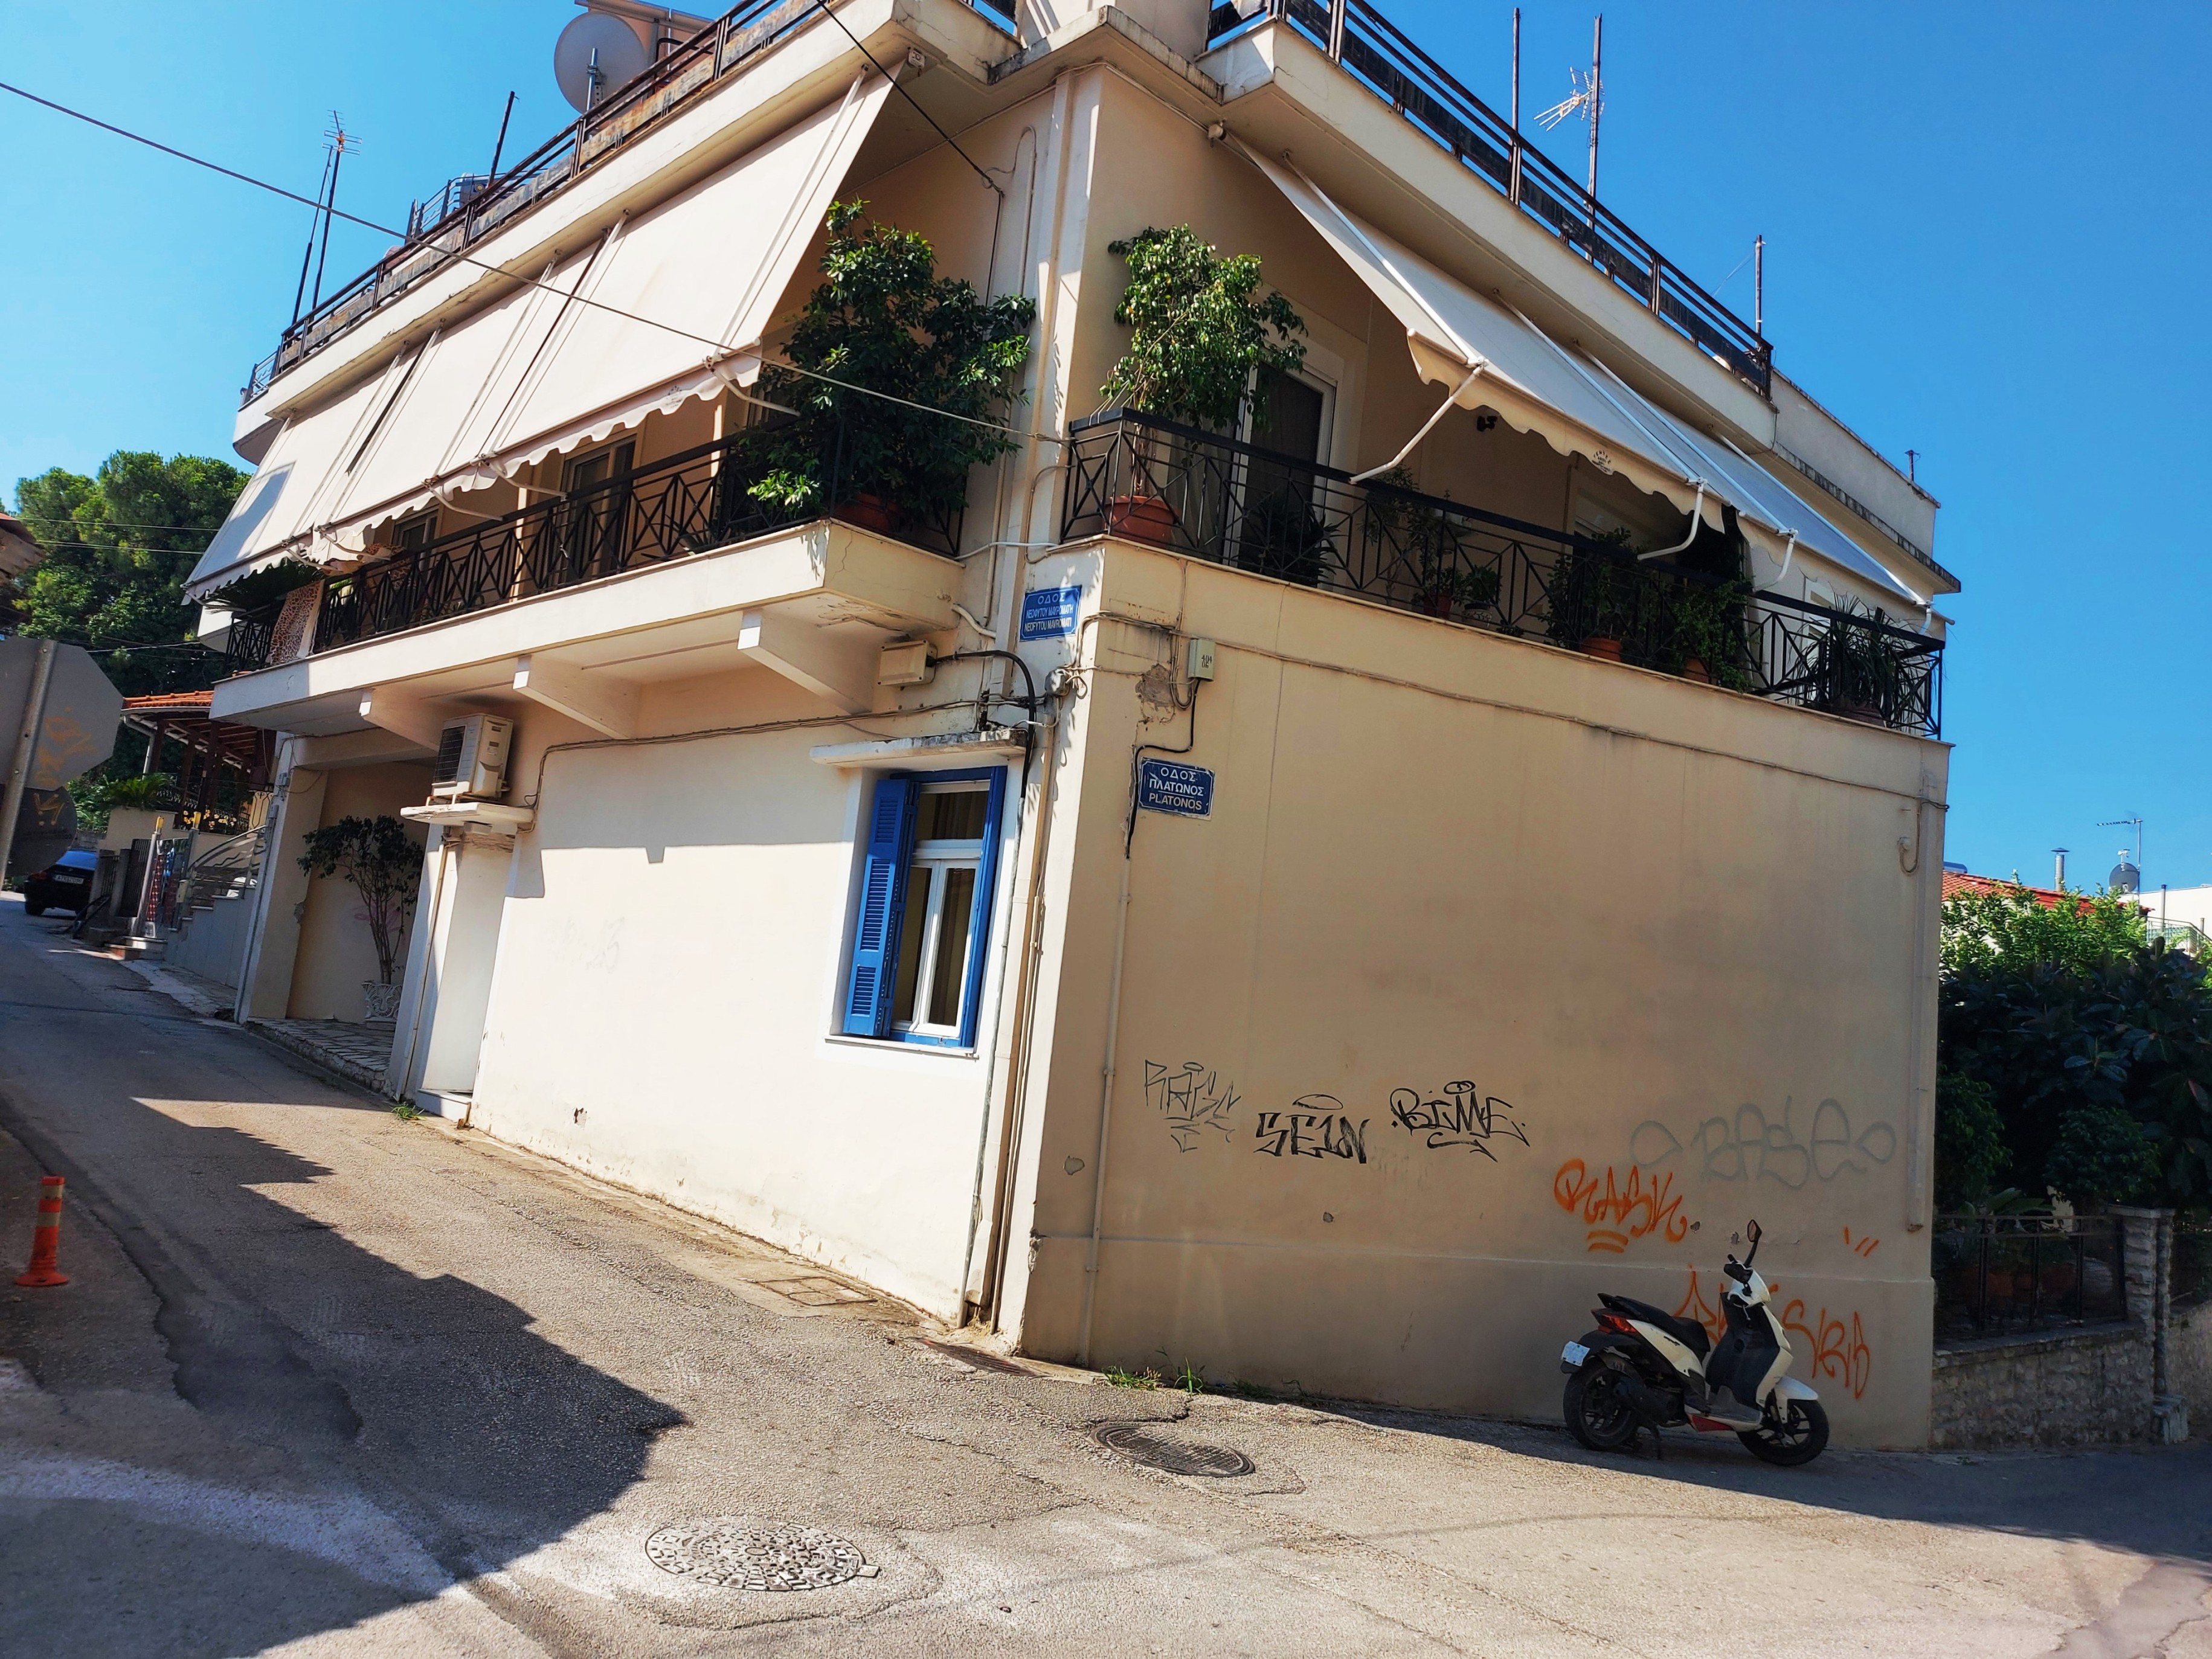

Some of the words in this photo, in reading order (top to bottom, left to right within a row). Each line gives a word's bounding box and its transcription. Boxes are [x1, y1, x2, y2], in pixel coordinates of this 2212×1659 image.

[1038, 592, 1066, 605] ΟΔΟΣ
[1160, 767, 1197, 782] ΟΔΟΣ
[1149, 778, 1204, 797] ΠΛΑΤΩΝΟΣ
[1149, 793, 1202, 810] PLATONOS
